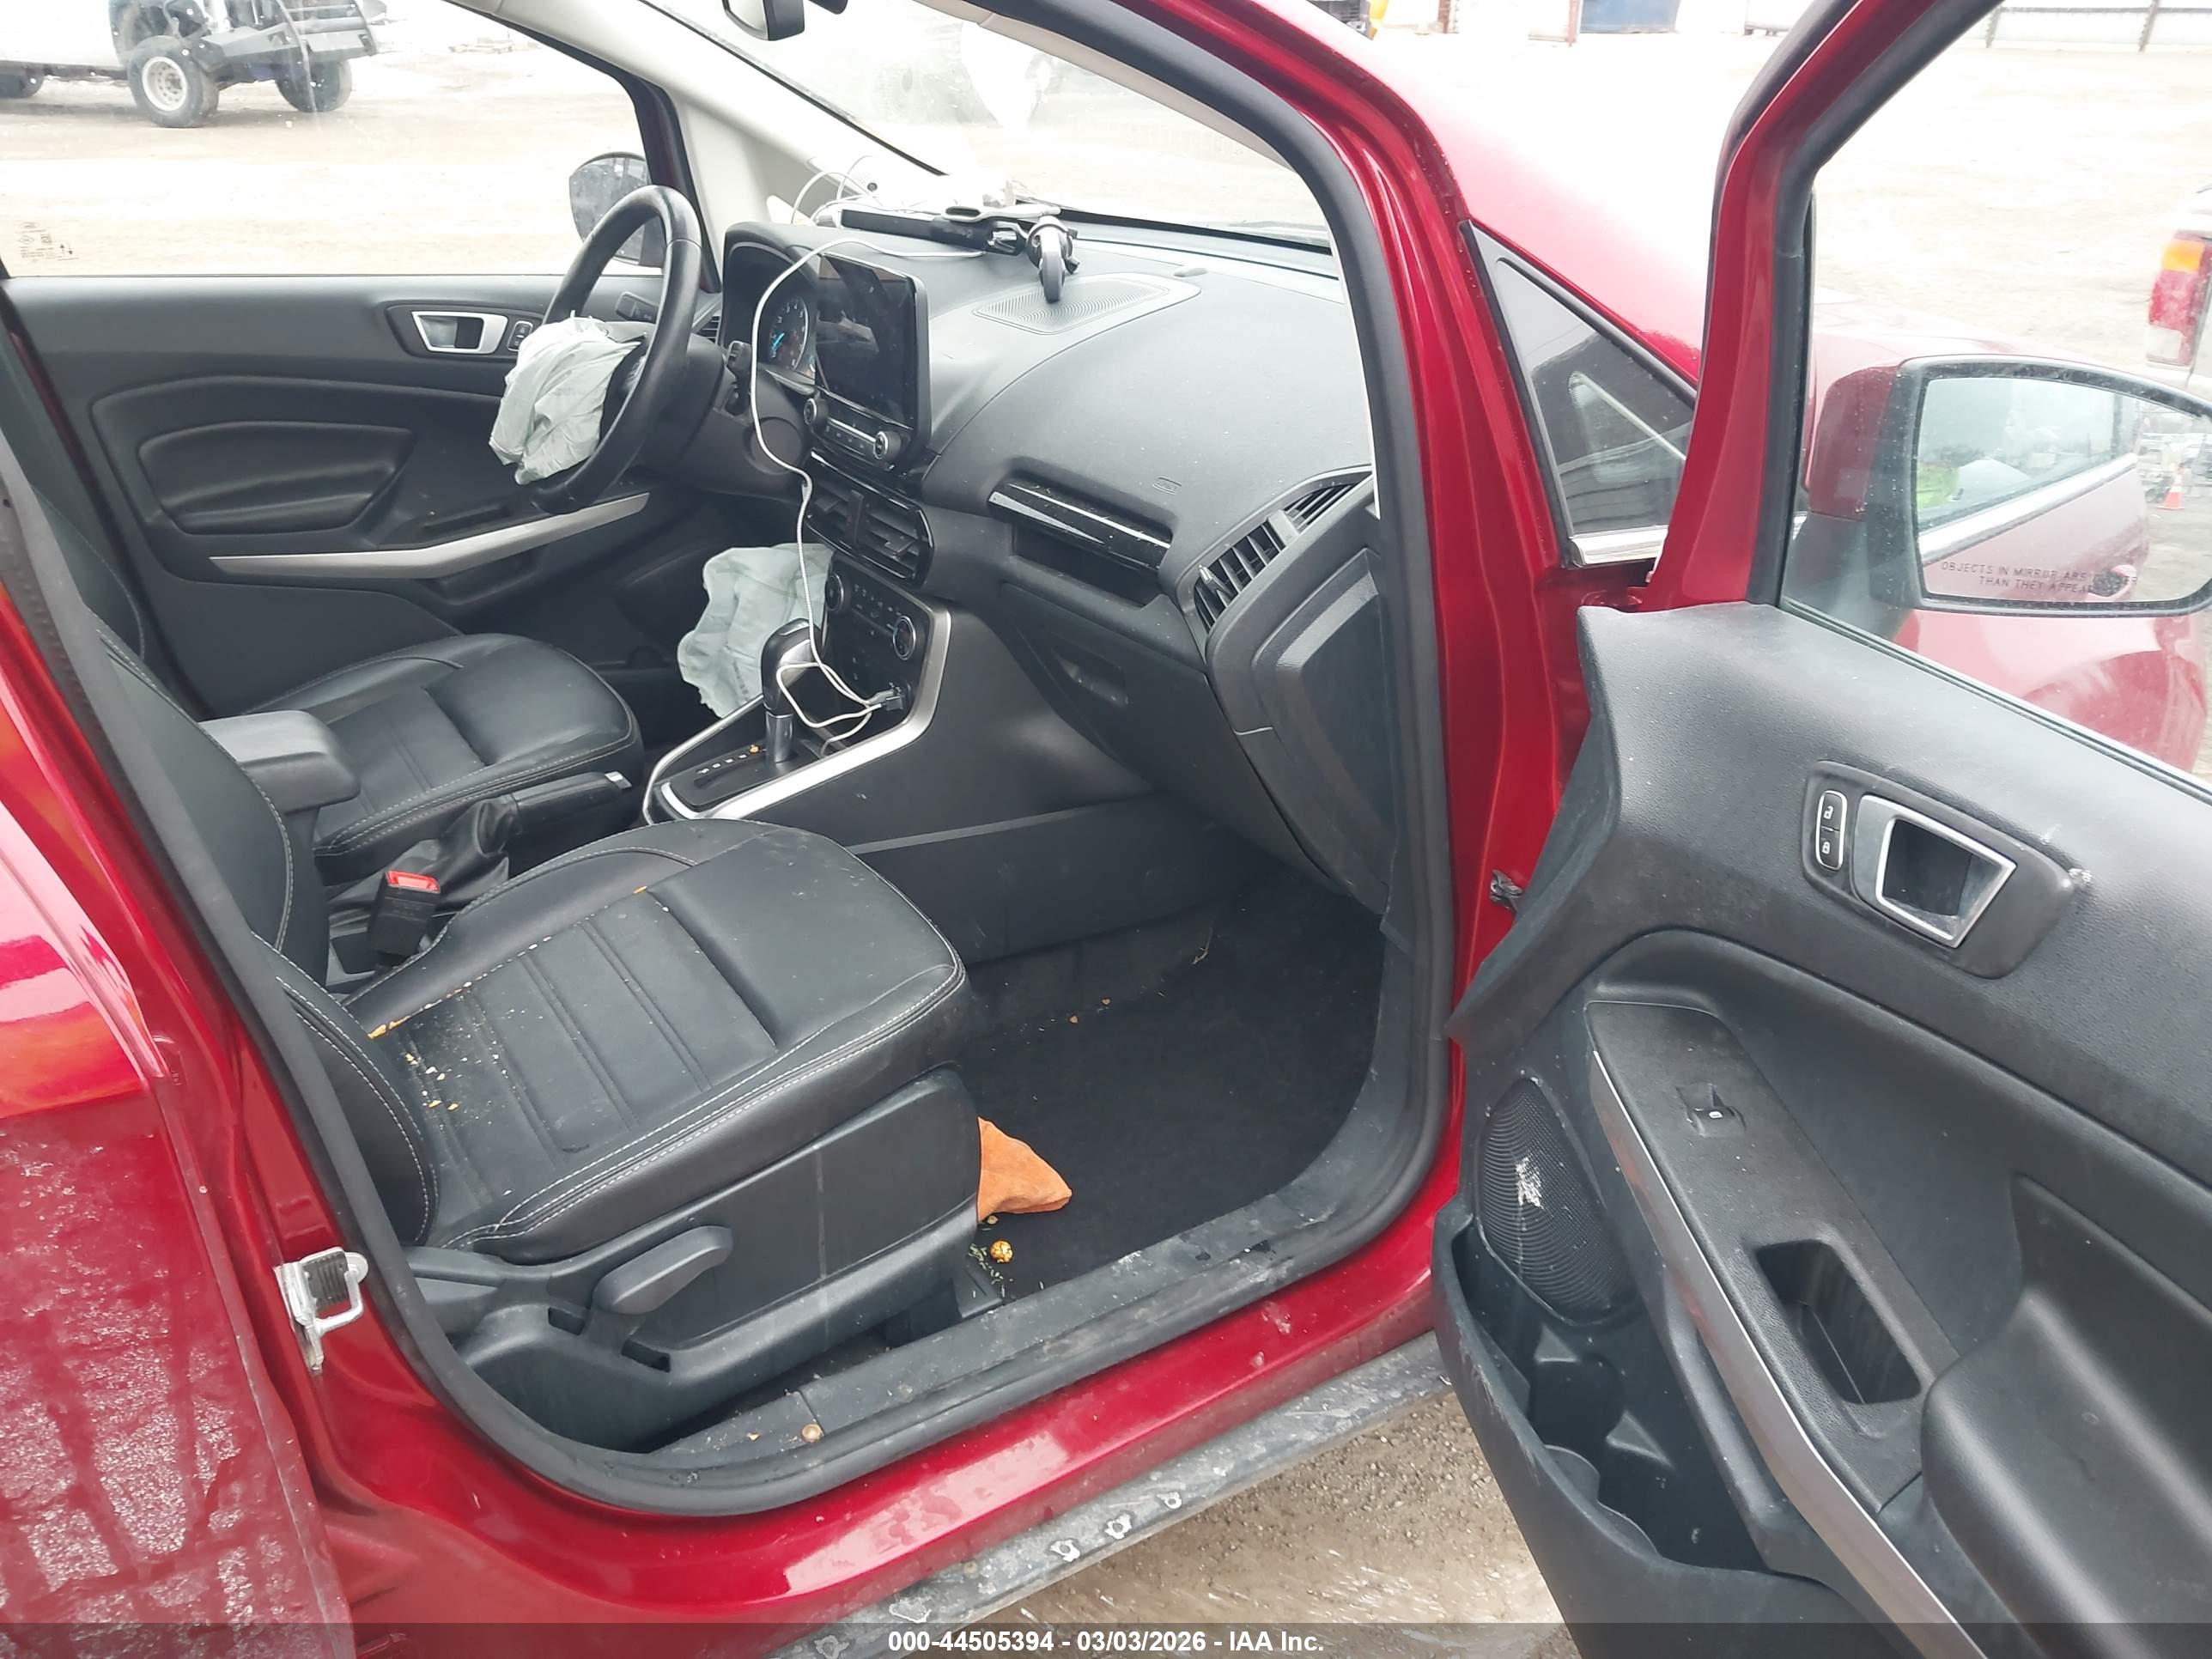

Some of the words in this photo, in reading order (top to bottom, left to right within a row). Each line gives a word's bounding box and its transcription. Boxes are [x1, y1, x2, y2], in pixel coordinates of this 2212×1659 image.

[1941, 561, 1994, 574] OBJECTS
[1998, 566, 2008, 575] IN
[2013, 568, 2058, 580] MIRROR
[1978, 575, 2009, 587] THAN
